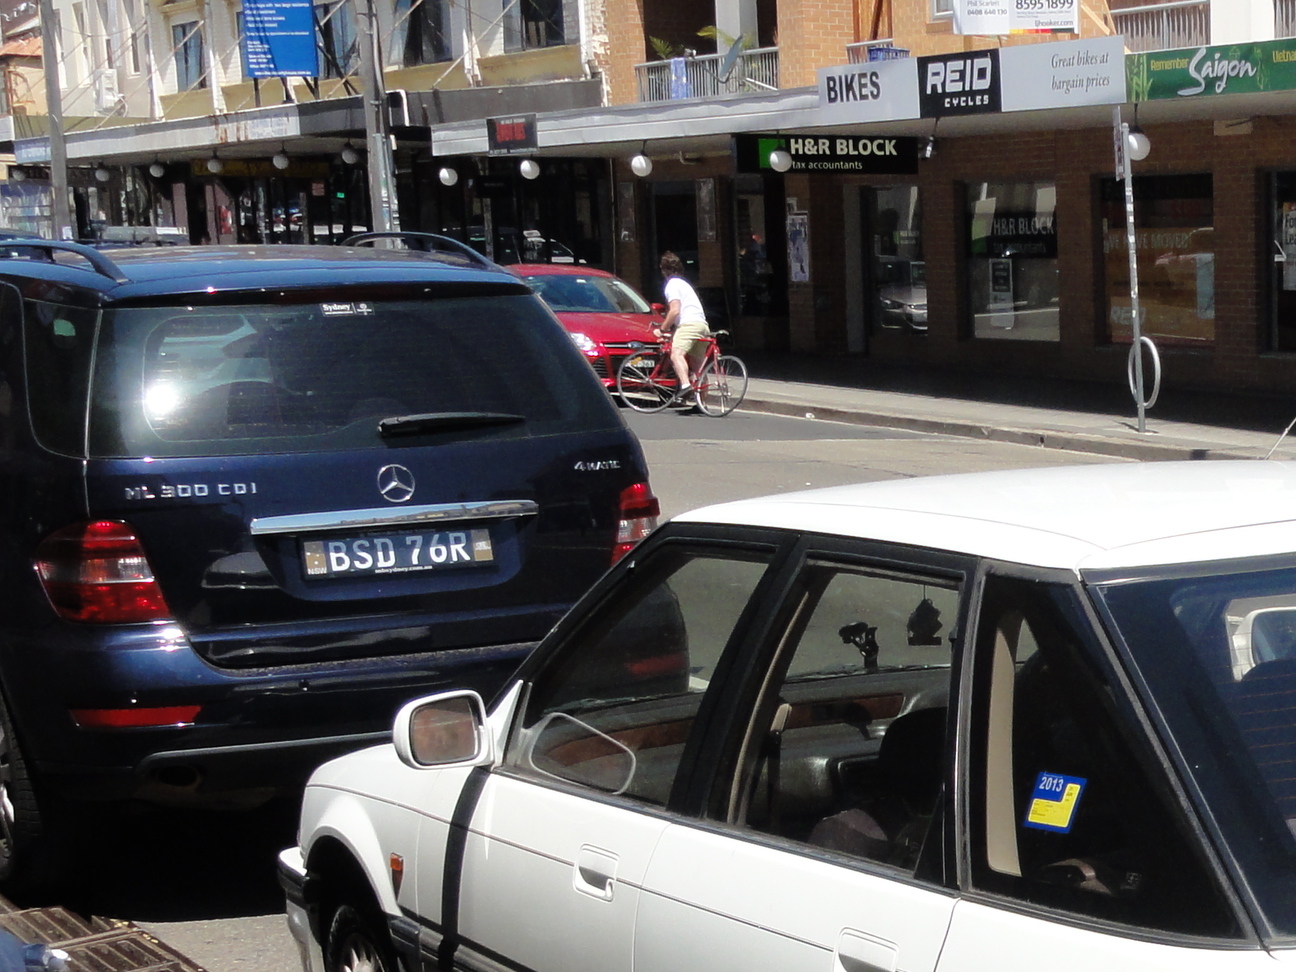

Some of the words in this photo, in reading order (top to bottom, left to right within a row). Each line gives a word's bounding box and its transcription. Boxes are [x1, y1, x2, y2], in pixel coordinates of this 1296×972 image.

[1016, 0, 1044, 10] 8595
[1047, 0, 1074, 9] 1899
[1051, 52, 1075, 68] Great
[1076, 51, 1098, 66] bikes
[1099, 51, 1109, 65] at
[926, 57, 992, 95] REID
[1151, 57, 1189, 71] Remember
[1177, 46, 1257, 96] Saigon
[826, 70, 881, 105] BIKES
[1051, 76, 1084, 94] bargain
[1085, 75, 1110, 93] prices
[944, 95, 990, 108] CYCLES
[789, 138, 831, 155] H&R
[836, 139, 898, 156] BLOCK
[792, 161, 806, 170] tax
[808, 160, 863, 170] accountants
[993, 218, 1016, 236] H&R
[1018, 216, 1055, 235] BLOCK
[322, 303, 351, 312] Sydney
[160, 483, 209, 498] 300
[217, 482, 257, 496] CDI
[328, 537, 396, 572] BSD
[405, 531, 471, 566] 76R
[307, 567, 327, 575] NSW
[1039, 776, 1064, 792] 2013
